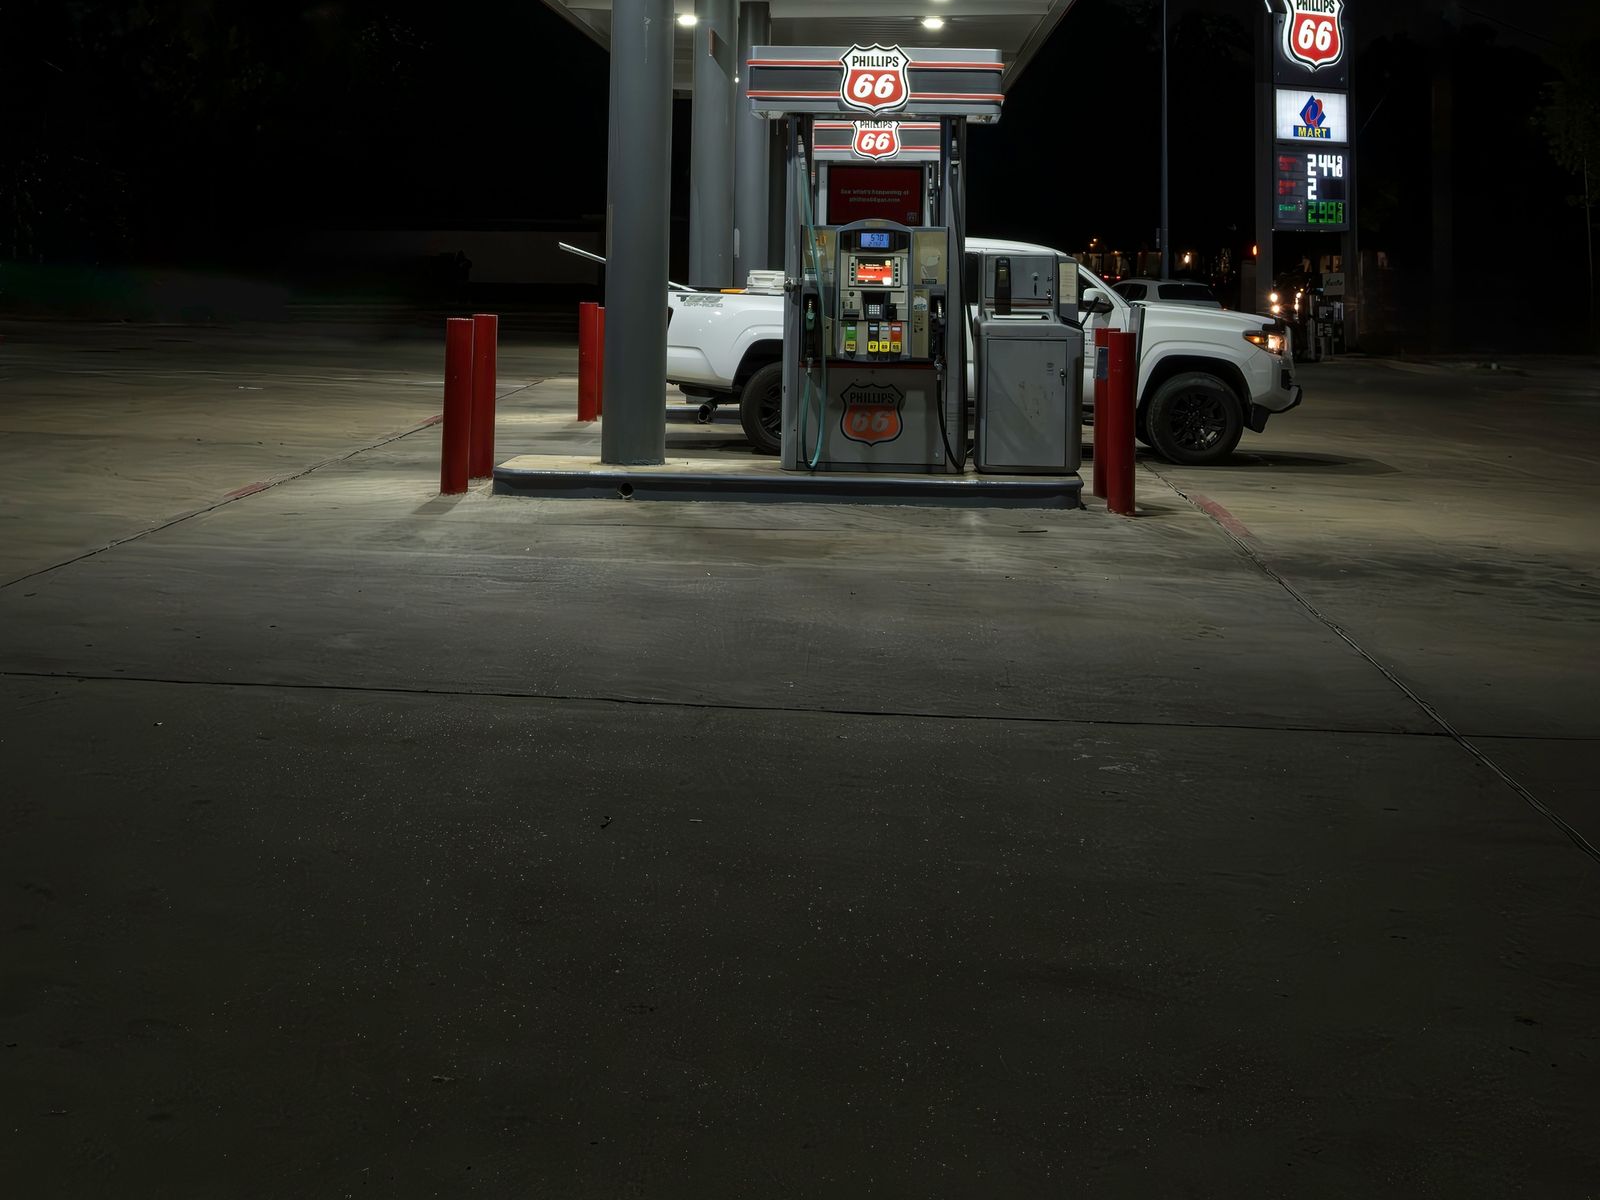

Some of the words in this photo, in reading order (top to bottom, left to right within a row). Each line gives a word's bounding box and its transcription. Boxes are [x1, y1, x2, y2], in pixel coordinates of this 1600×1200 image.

[1298, 18, 1333, 51] 66
[852, 55, 899, 67] PHILLIPS
[853, 73, 896, 99] 66
[860, 132, 891, 150] 66
[1298, 126, 1327, 138] MART
[1307, 178, 1317, 200] 2
[850, 392, 895, 404] PHILLIPS
[851, 410, 891, 433] 66
